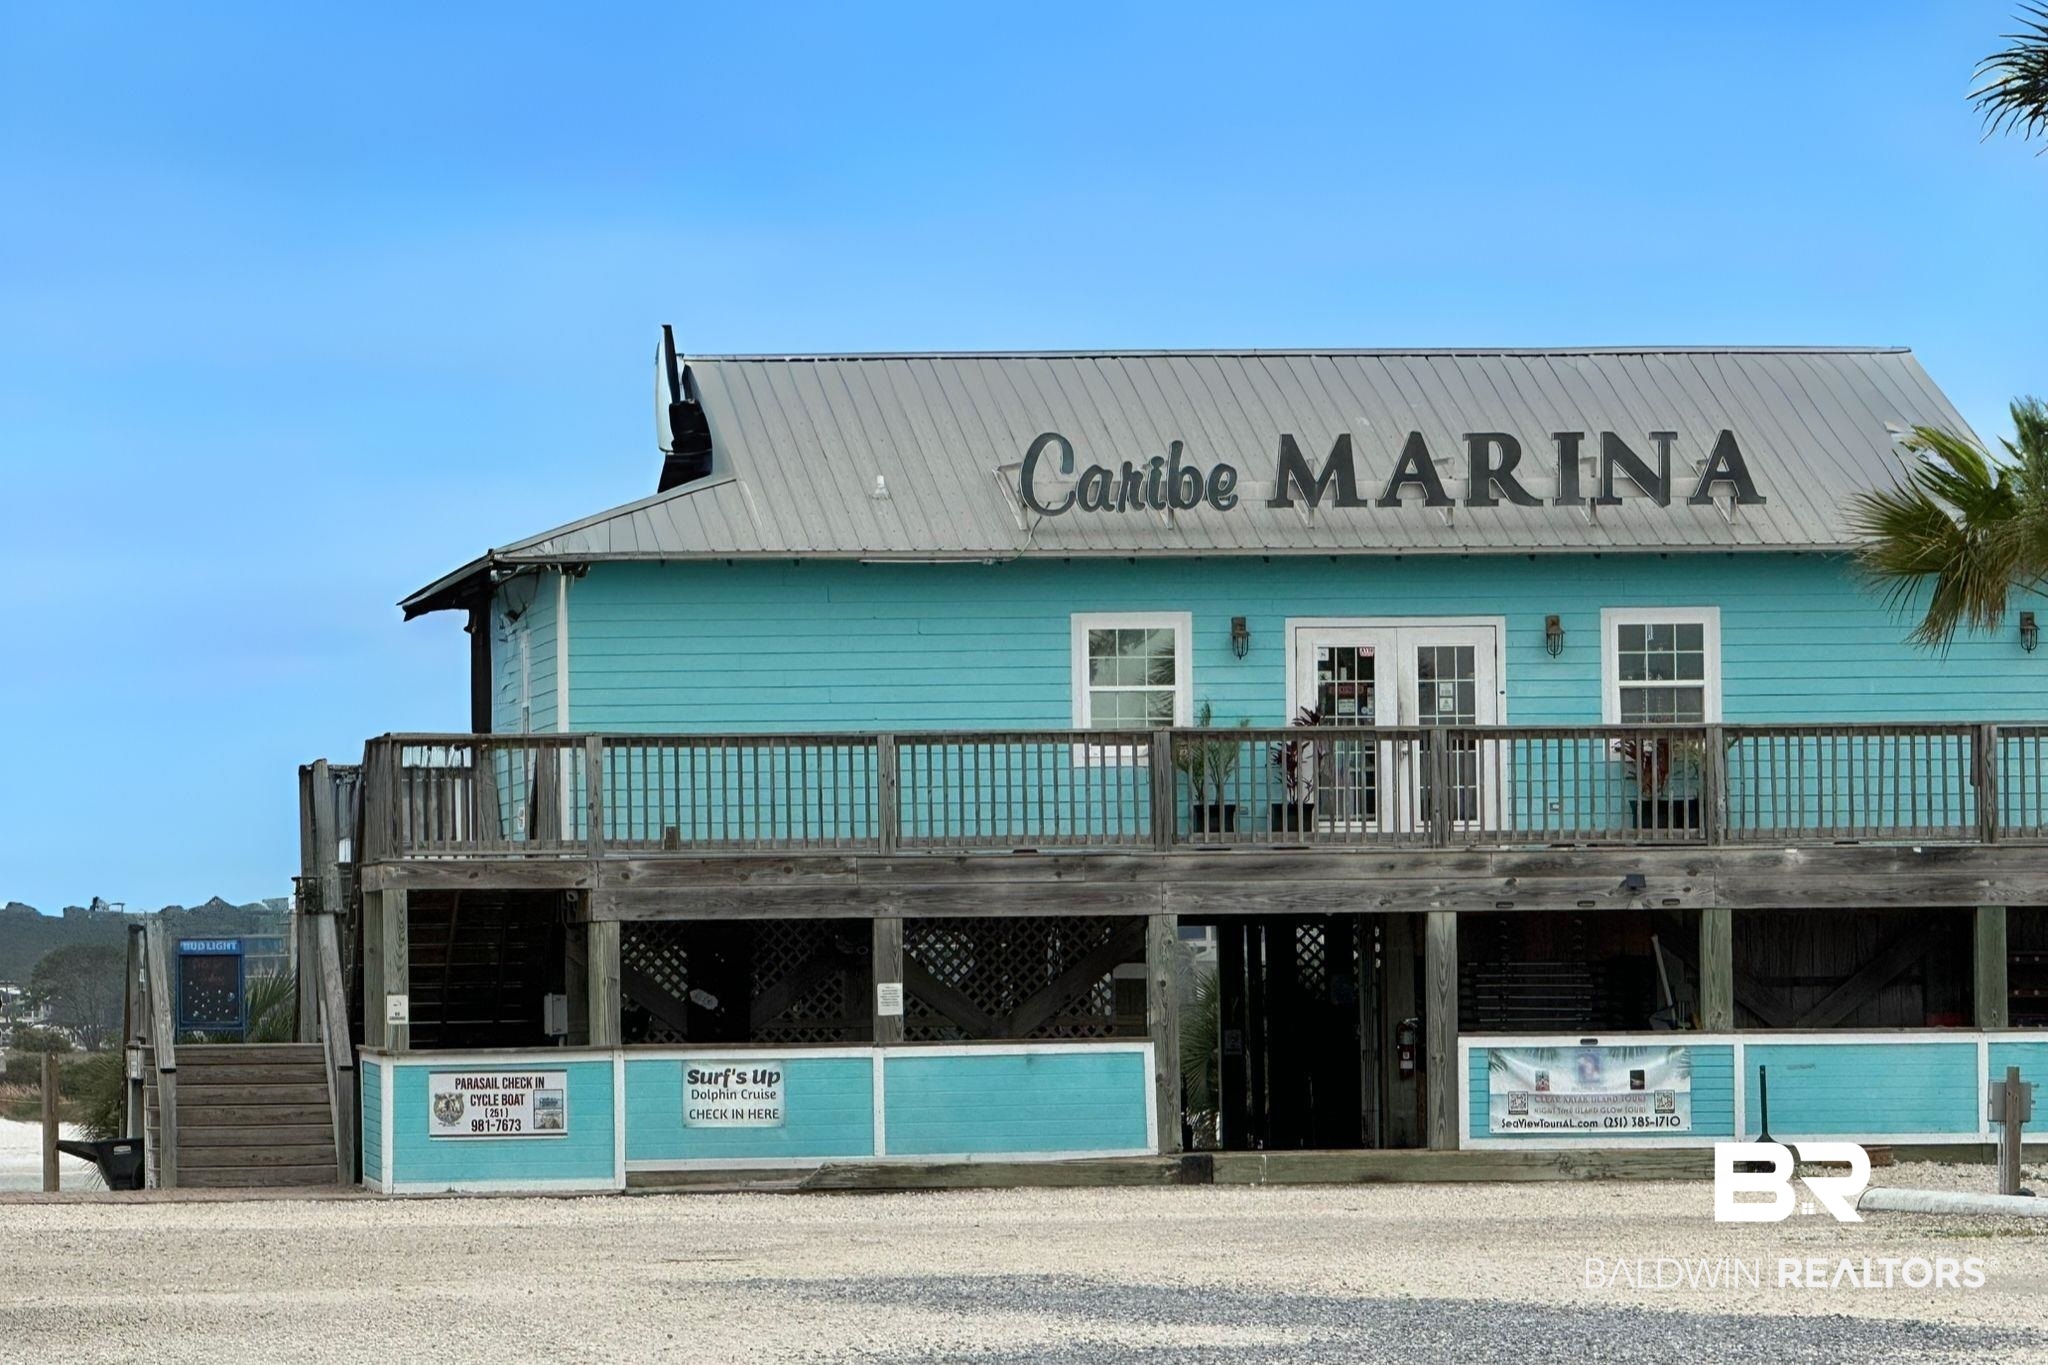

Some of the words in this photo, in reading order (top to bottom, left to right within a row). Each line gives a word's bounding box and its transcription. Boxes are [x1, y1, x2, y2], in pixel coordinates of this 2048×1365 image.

[1019, 431, 1239, 517] Caribe
[1264, 428, 1768, 509] MARINA
[183, 941, 206, 951] BUD
[206, 940, 237, 950] LIGHT
[455, 1077, 500, 1090] PARASAIL
[502, 1076, 533, 1089] CHECK
[535, 1076, 545, 1089] IN
[687, 1068, 747, 1088] Surf's
[752, 1069, 781, 1088] Up
[470, 1094, 499, 1106] CYCLE
[501, 1093, 526, 1106] BOAT
[691, 1088, 737, 1102] Dolphin
[741, 1088, 776, 1100] Cruise
[689, 1108, 728, 1120] CHECK
[731, 1108, 744, 1119] IN
[748, 1108, 780, 1119] HERE
[1599, 1106, 1623, 1114] GLOW
[471, 1118, 522, 1133] 981-7673
[1501, 1117, 1599, 1129] SeaViewToursAL.com
[1603, 1115, 1628, 1129] (251)
[1632, 1115, 1681, 1128] 385-1710
